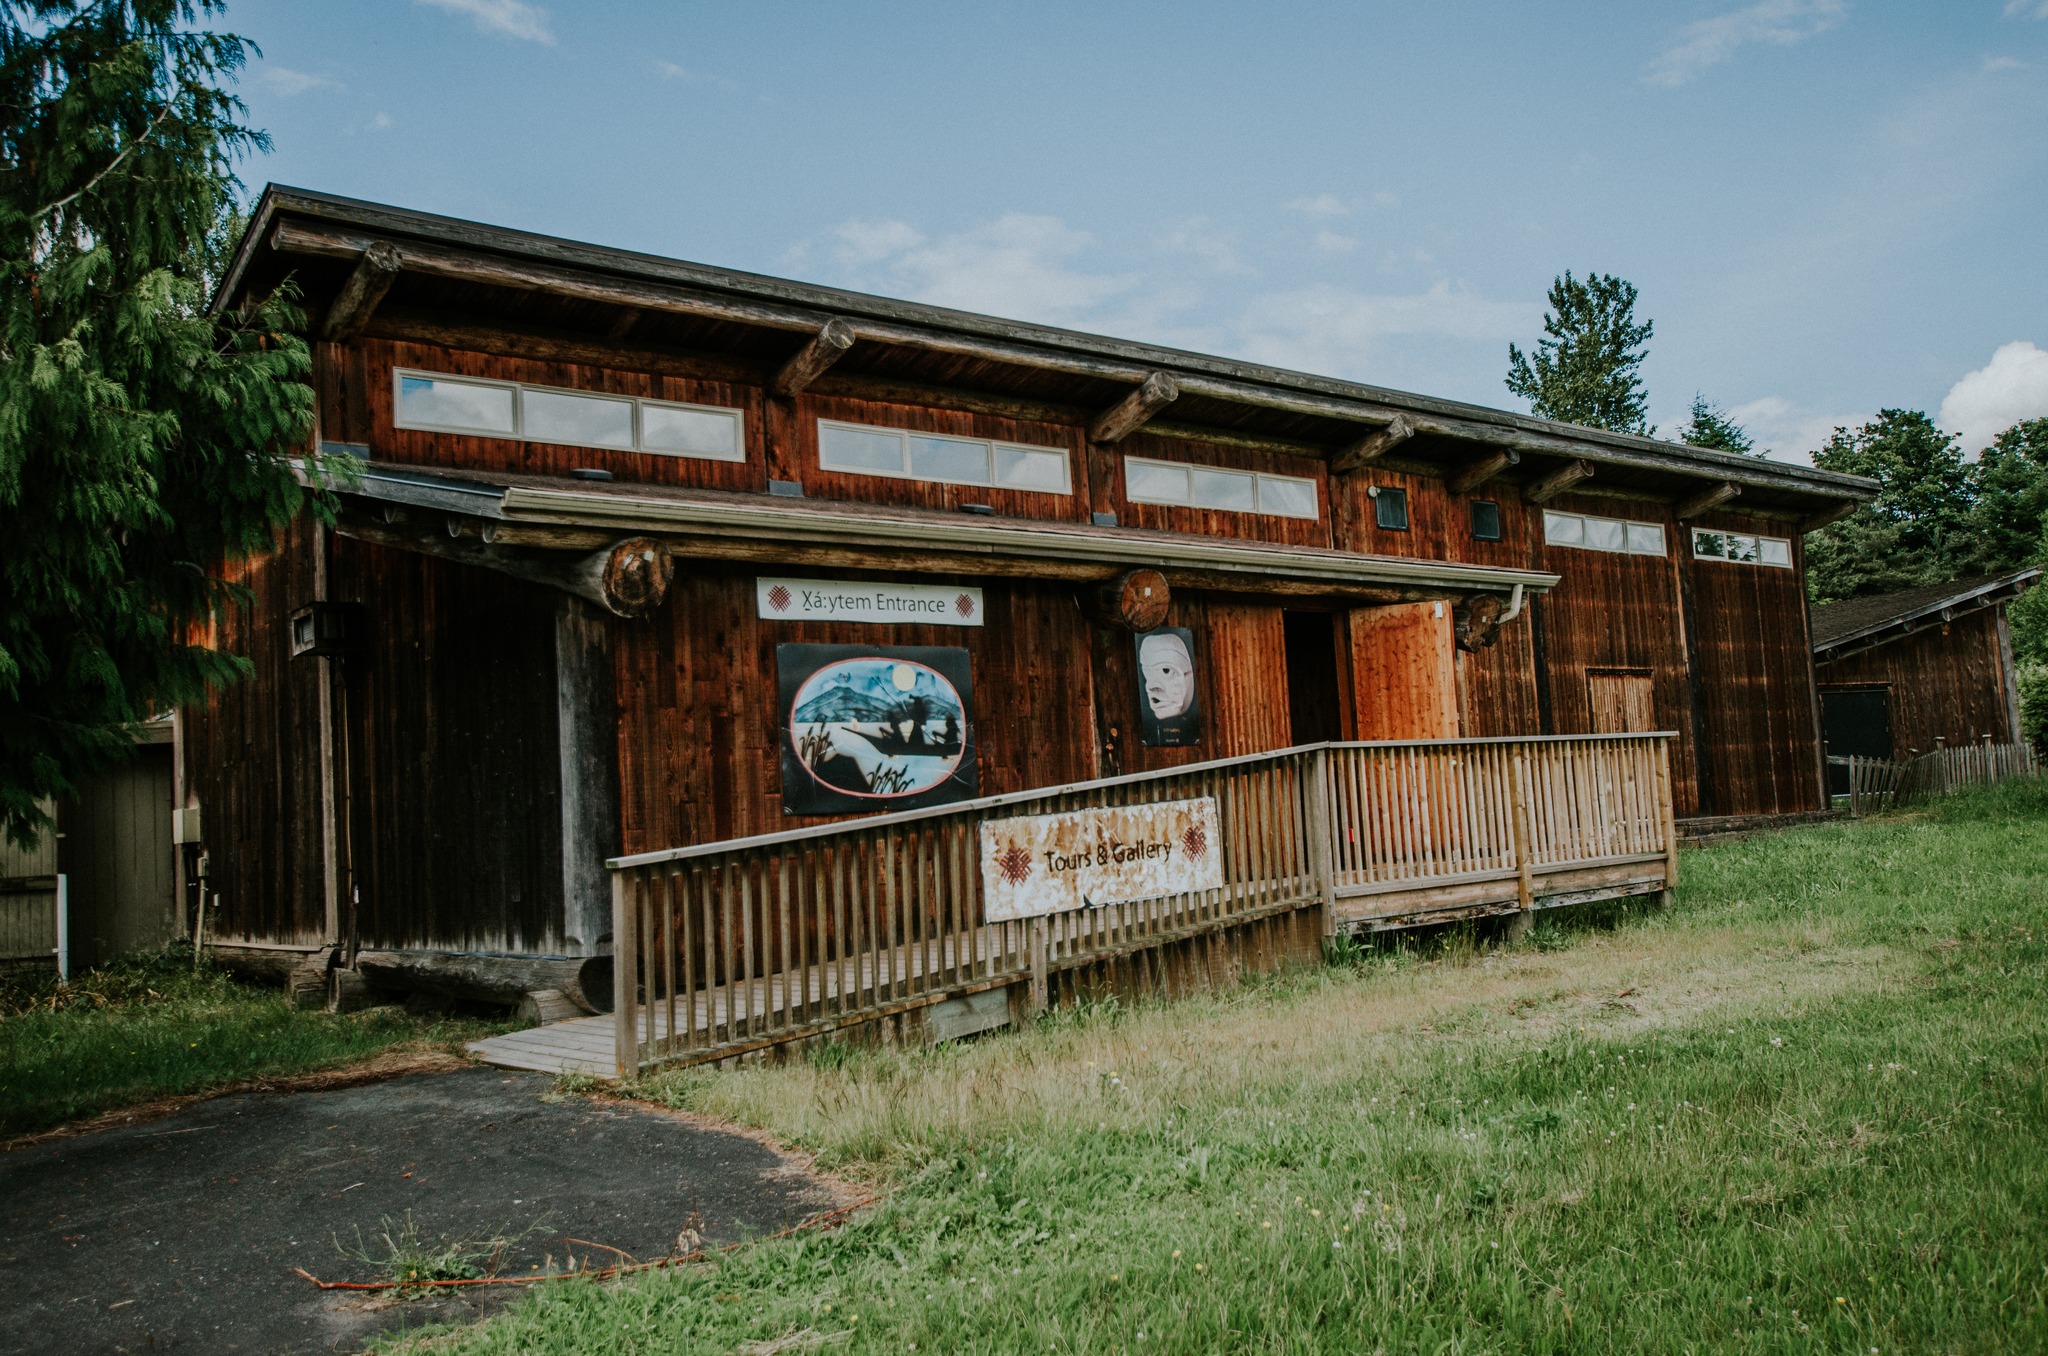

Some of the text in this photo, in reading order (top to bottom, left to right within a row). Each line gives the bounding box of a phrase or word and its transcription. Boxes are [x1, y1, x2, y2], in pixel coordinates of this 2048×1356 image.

[877, 593, 945, 612] Entrance
[1044, 840, 1172, 873] Tours & Gallery
